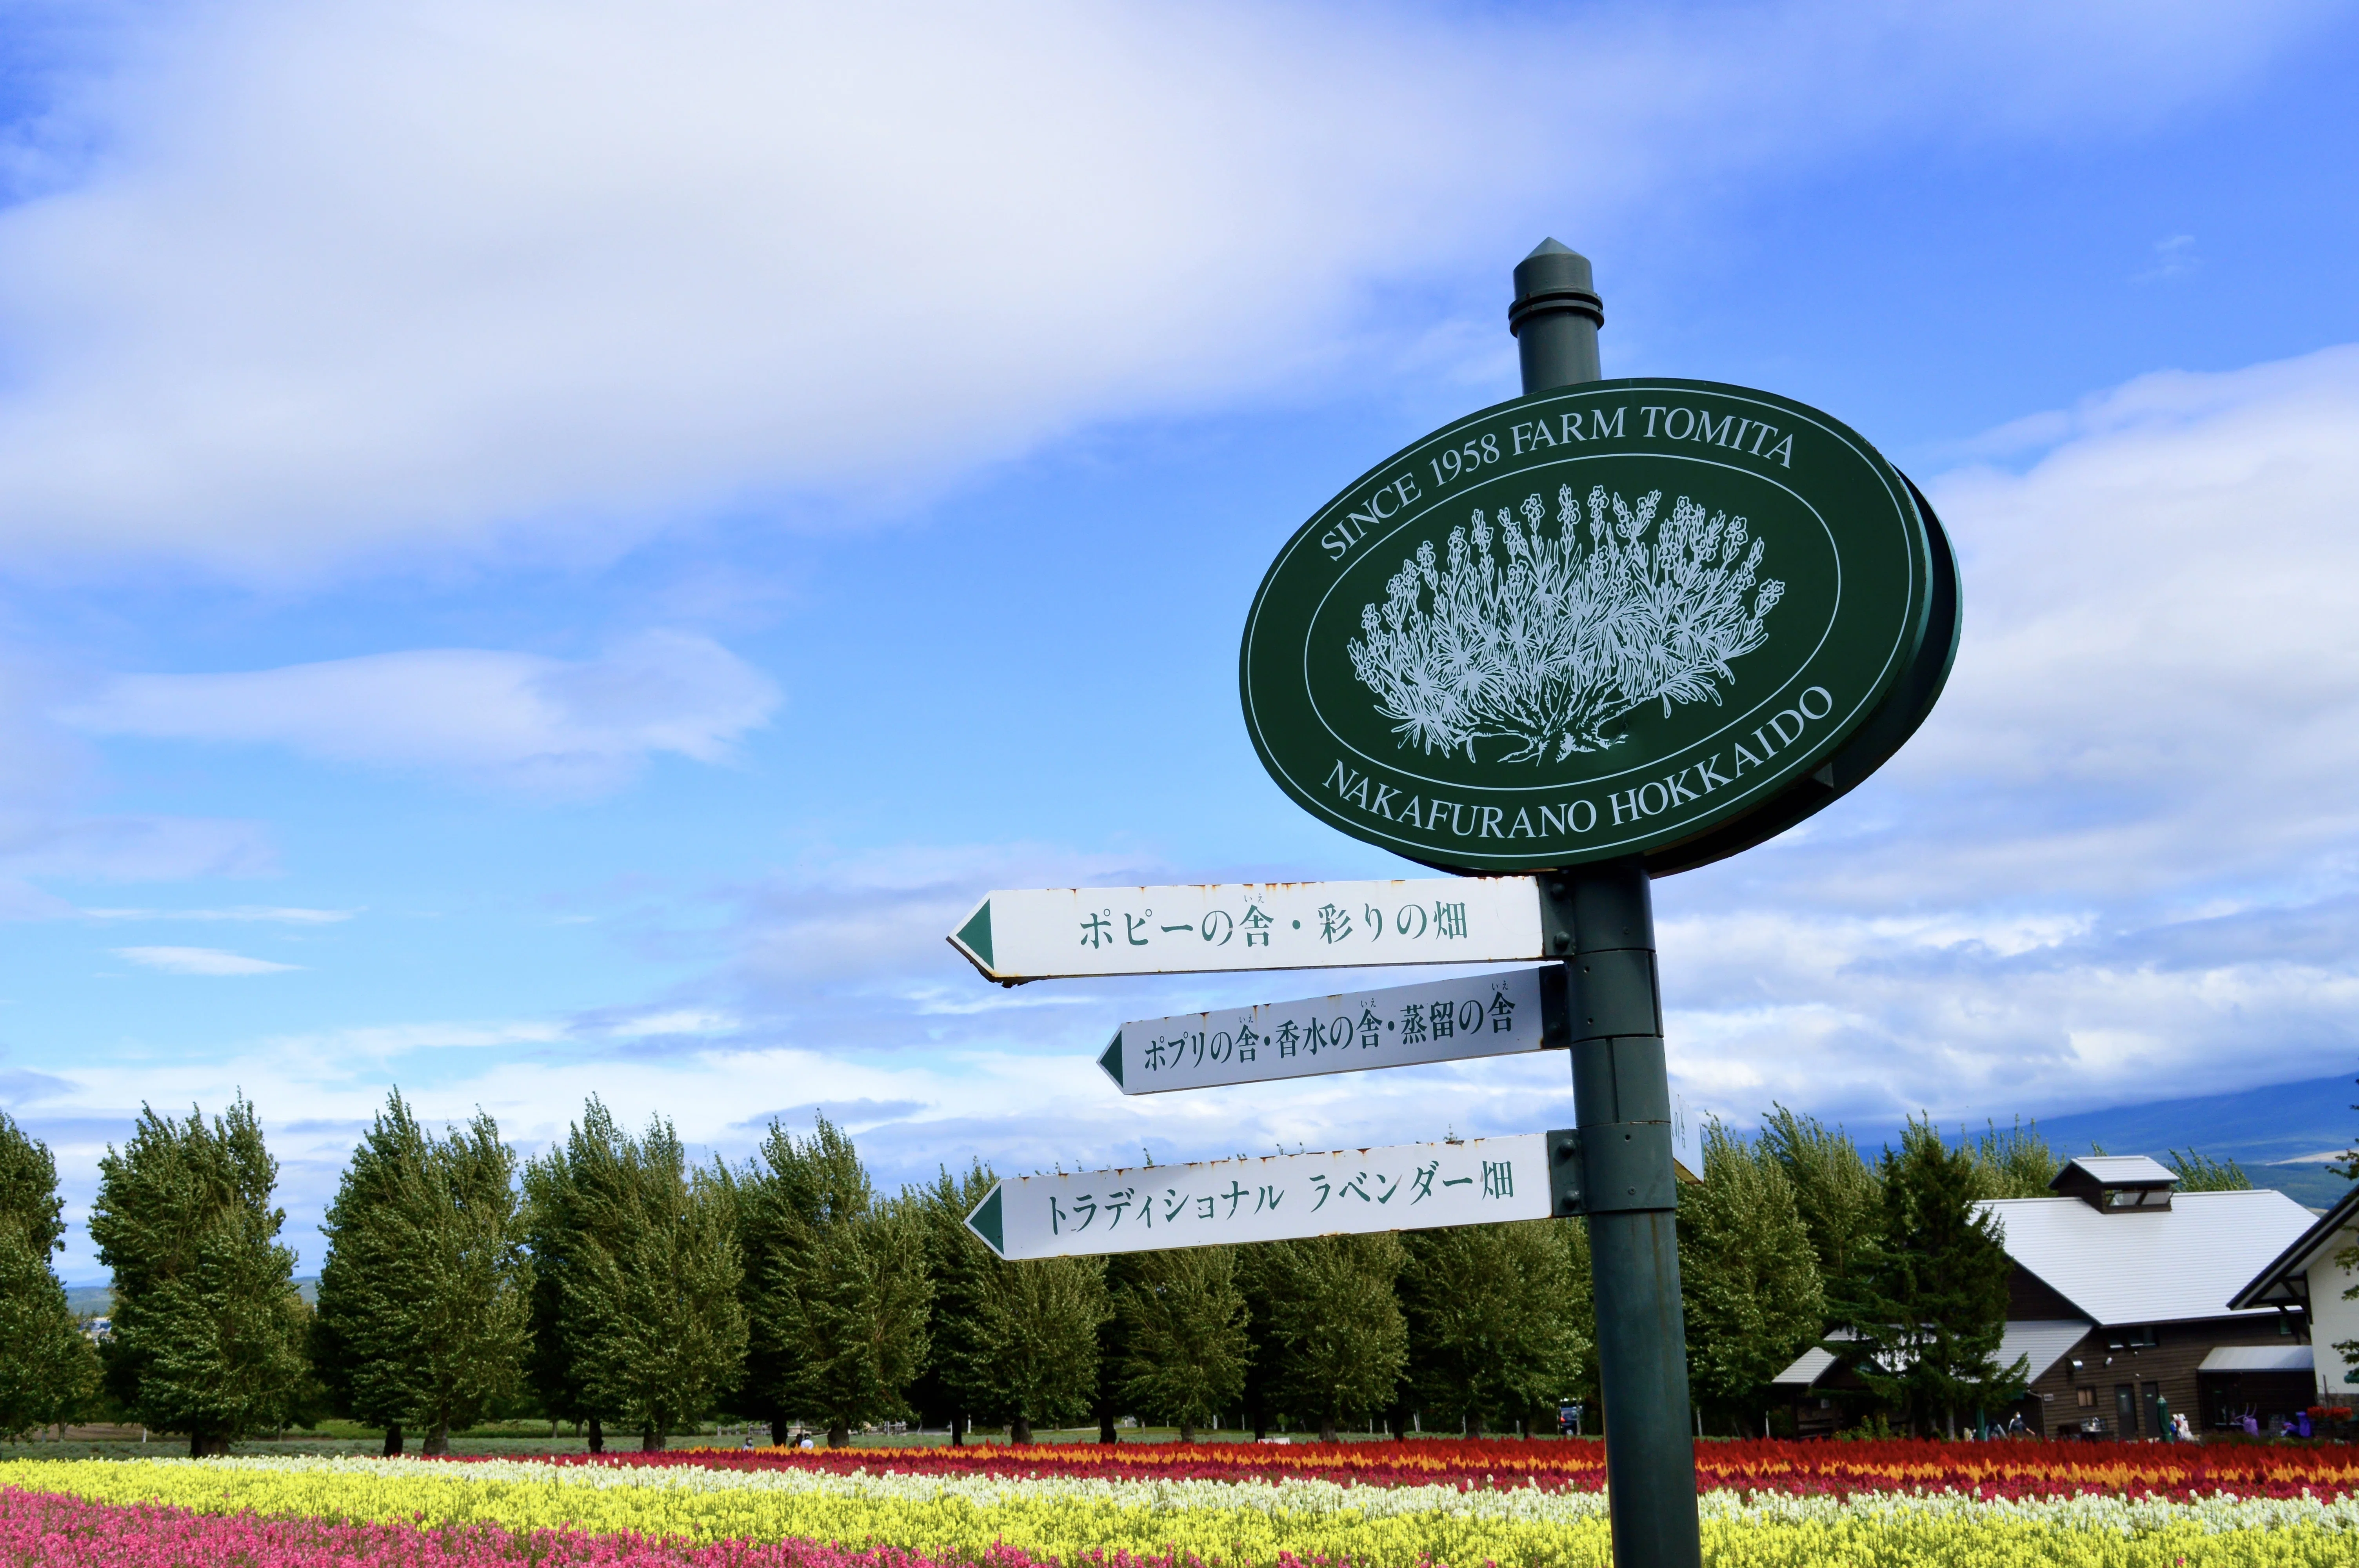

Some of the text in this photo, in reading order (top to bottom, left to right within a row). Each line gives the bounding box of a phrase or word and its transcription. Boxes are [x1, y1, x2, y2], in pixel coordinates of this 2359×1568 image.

[1321, 406, 1793, 562] SINCE 1958 FARM TOMITA
[1321, 686, 1832, 838] NAKAFURANO HOKKAIDO
[1244, 893, 1265, 903] いえ
[1491, 980, 1508, 991] いえ
[1360, 997, 1376, 1008] いえ
[1239, 1014, 1254, 1024] いえ
[1670, 1111, 1686, 1150] の舎
[1049, 1160, 1514, 1235] トラディショナル ラベンダー畑
